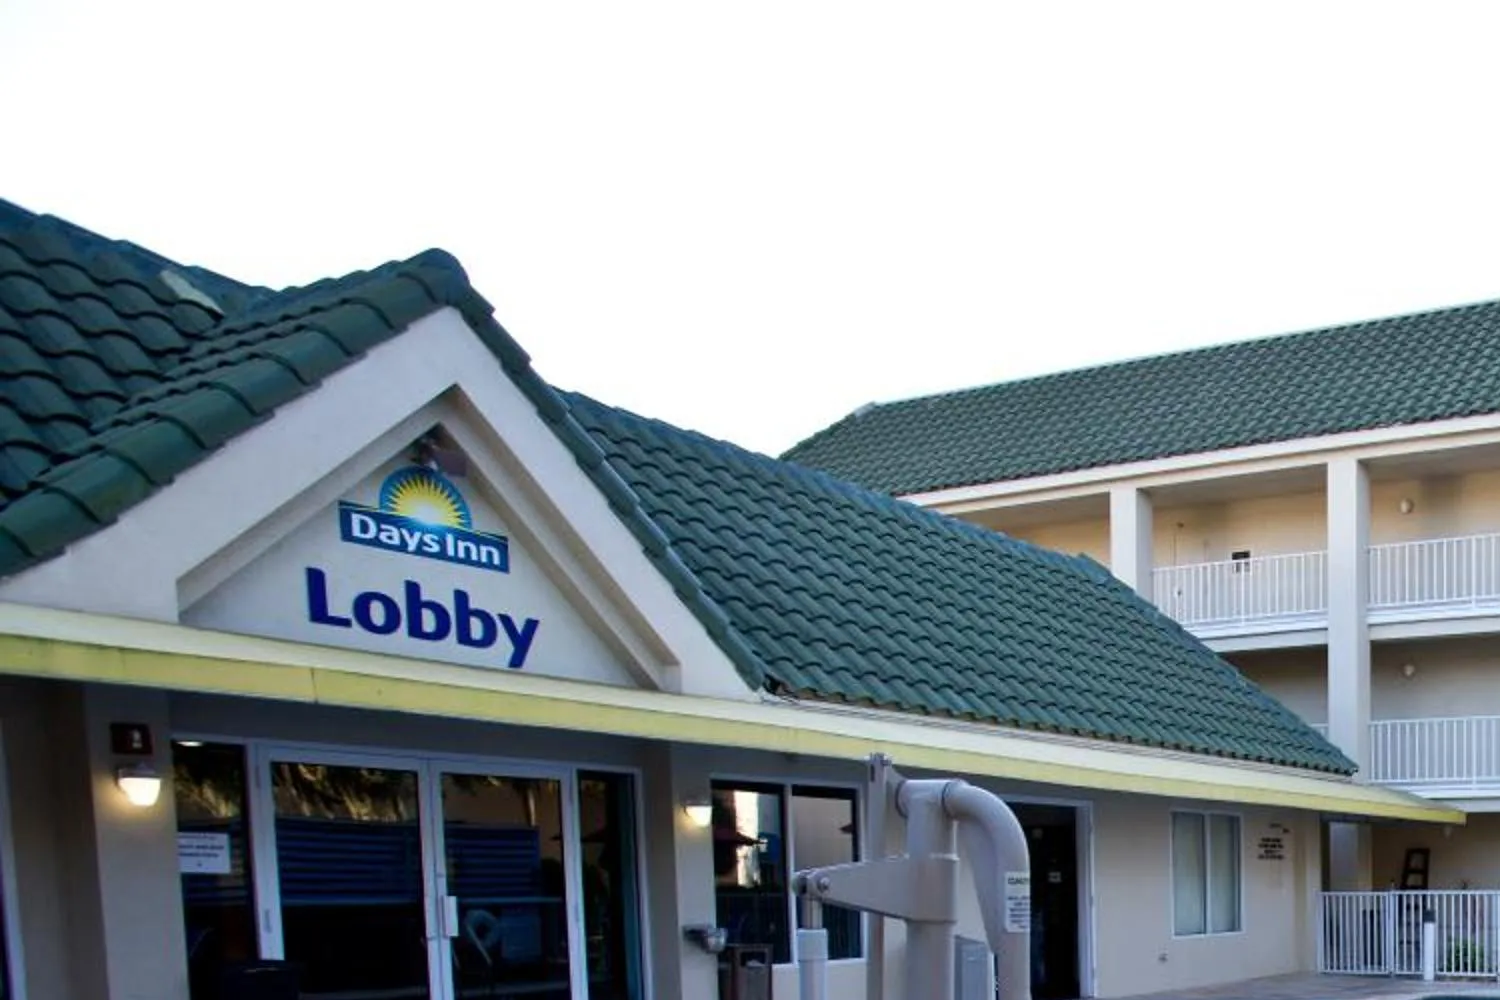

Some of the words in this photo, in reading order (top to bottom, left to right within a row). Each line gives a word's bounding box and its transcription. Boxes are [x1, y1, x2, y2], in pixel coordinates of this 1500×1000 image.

[351, 513, 441, 552] Days
[446, 533, 501, 566] Inn
[306, 566, 540, 669] Lobby
